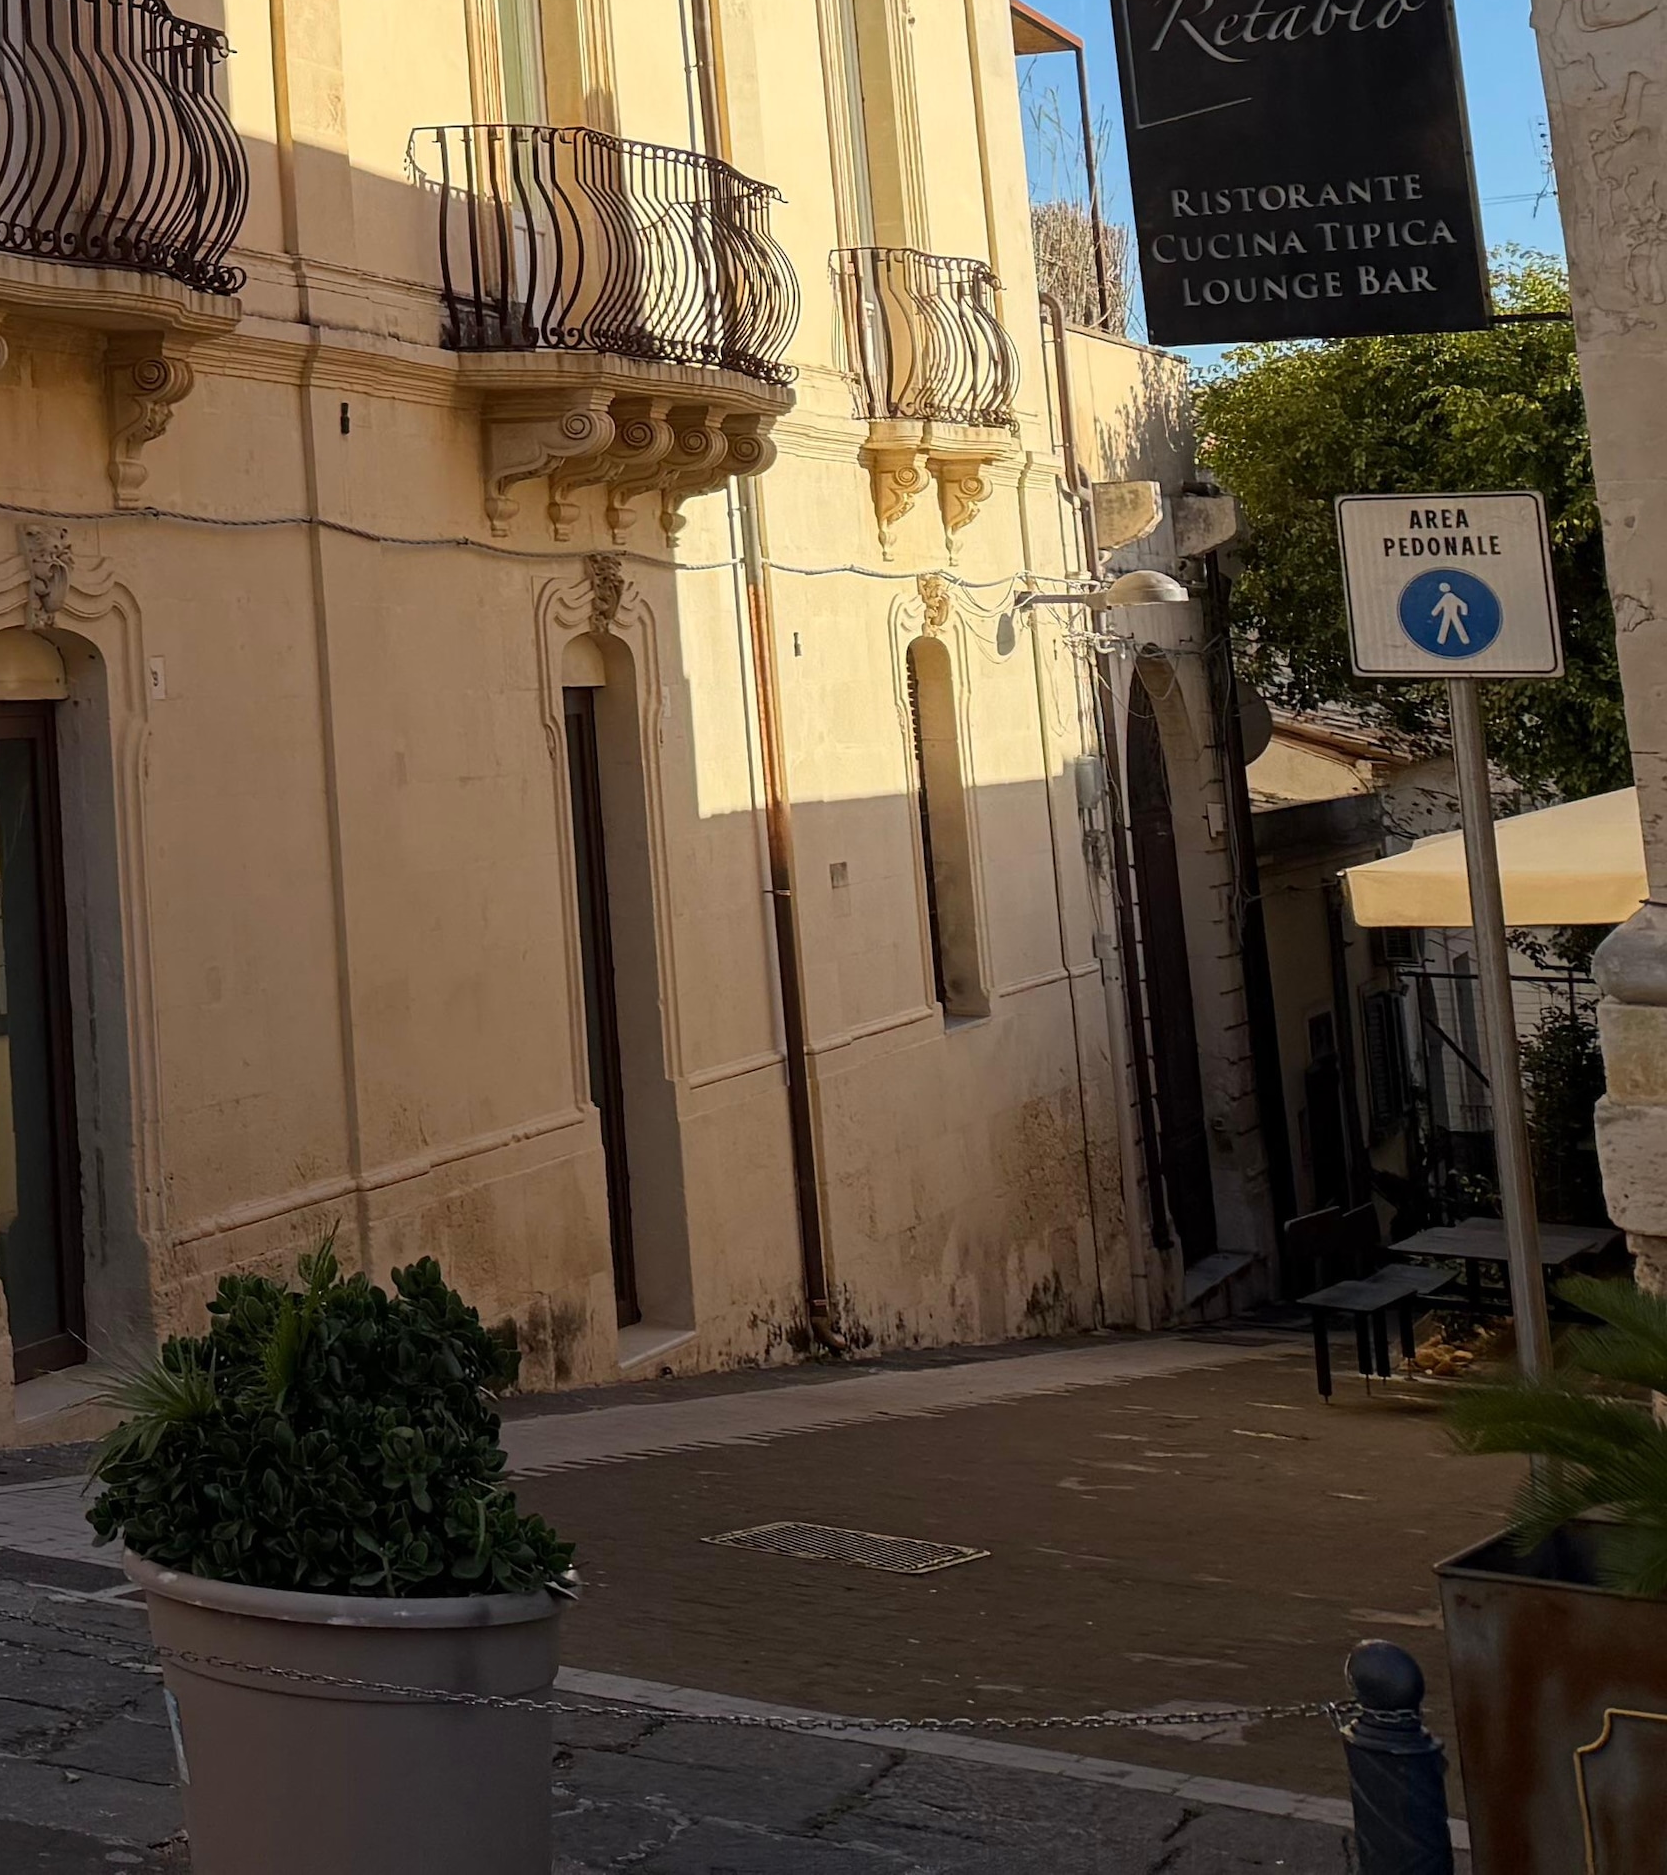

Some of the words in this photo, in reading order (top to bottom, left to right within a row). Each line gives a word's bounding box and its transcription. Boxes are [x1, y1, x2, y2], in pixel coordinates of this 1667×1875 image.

[1170, 173, 1424, 218] RISTORANTE
[1151, 226, 1307, 265] CUCINA
[1315, 218, 1457, 253] TIPICA
[1182, 270, 1343, 308] LOUNGE
[1358, 263, 1438, 297] BAR
[1409, 508, 1469, 530] AREA
[1383, 535, 1502, 557] PEDONALE
